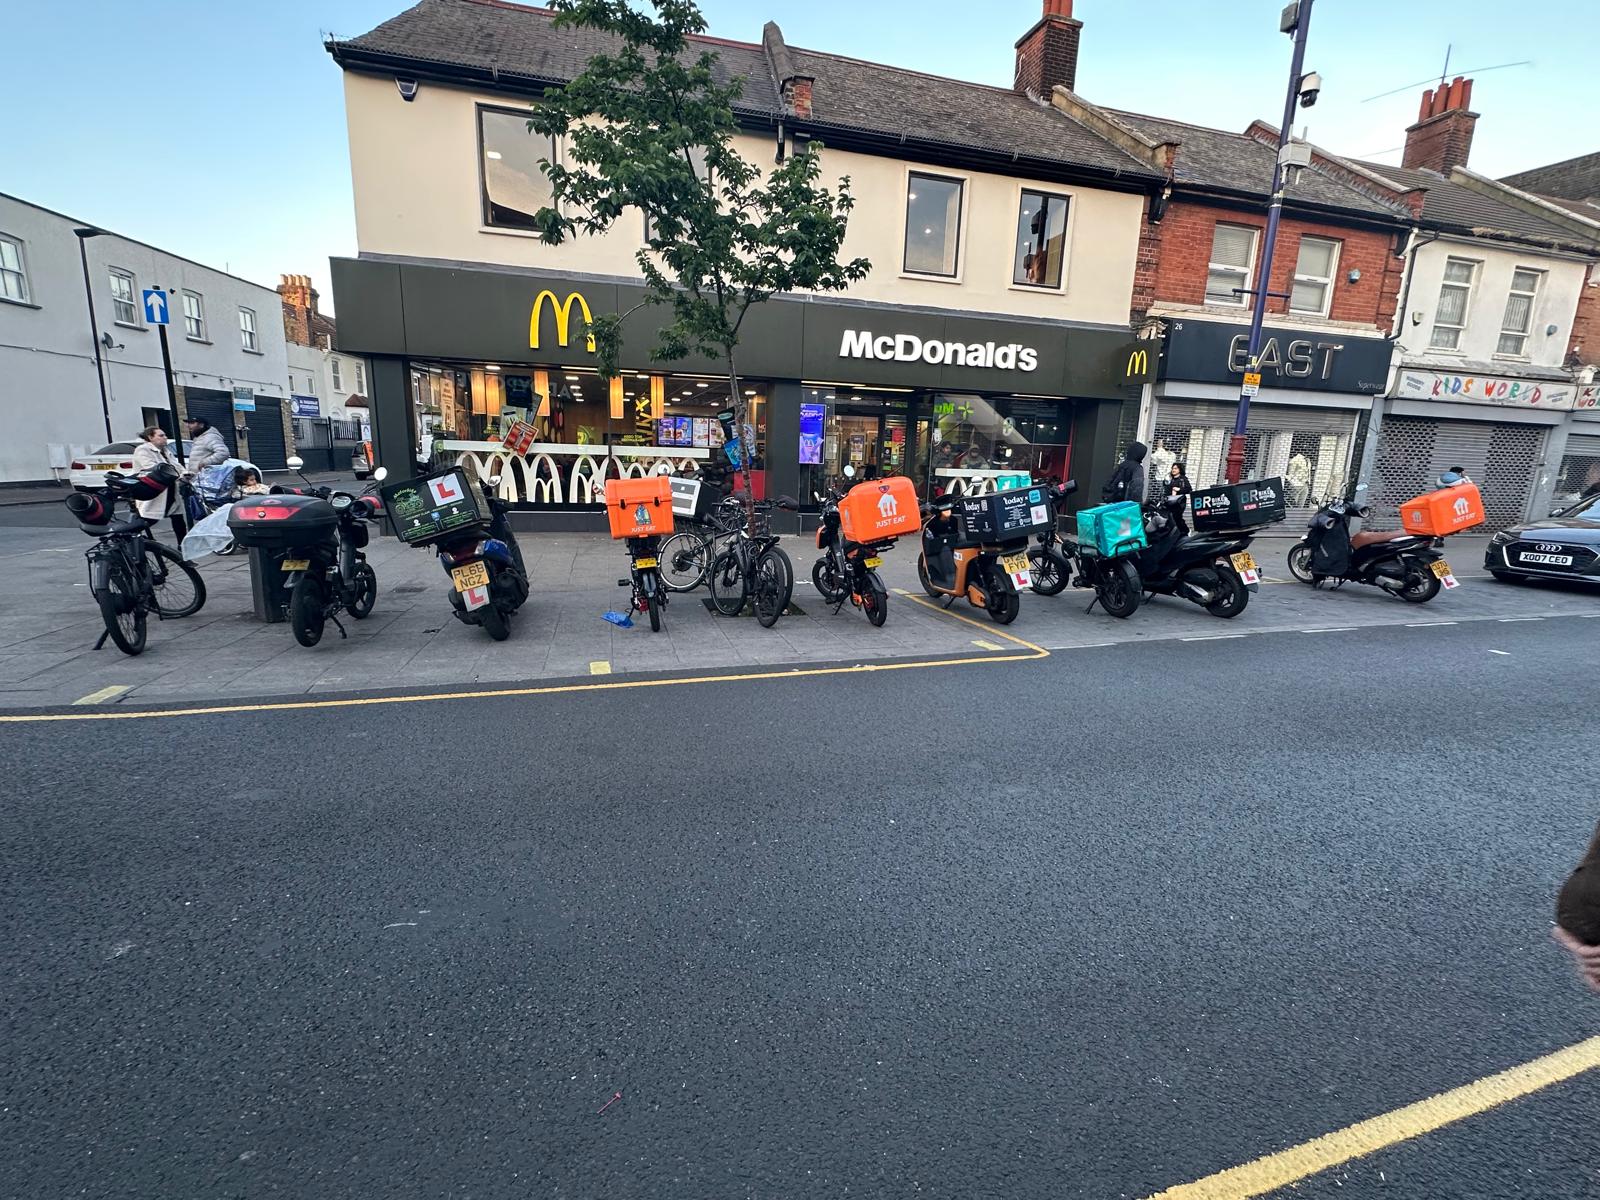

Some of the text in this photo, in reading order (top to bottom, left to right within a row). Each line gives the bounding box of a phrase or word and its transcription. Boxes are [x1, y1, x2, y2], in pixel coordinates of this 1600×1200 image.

[1174, 323, 1183, 331] 26
[839, 329, 1038, 372] McDonald's
[1228, 334, 1345, 380] EAST
[1431, 376, 1542, 405] KIDS WORLD
[436, 482, 456, 499] L
[1194, 496, 1212, 509] BR
[876, 514, 906, 528] JUST EAT
[1548, 555, 1568, 564] CEO
[1015, 573, 1028, 586] L
[1245, 570, 1256, 582] L
[1443, 577, 1454, 587] L
[467, 588, 484, 606] L
